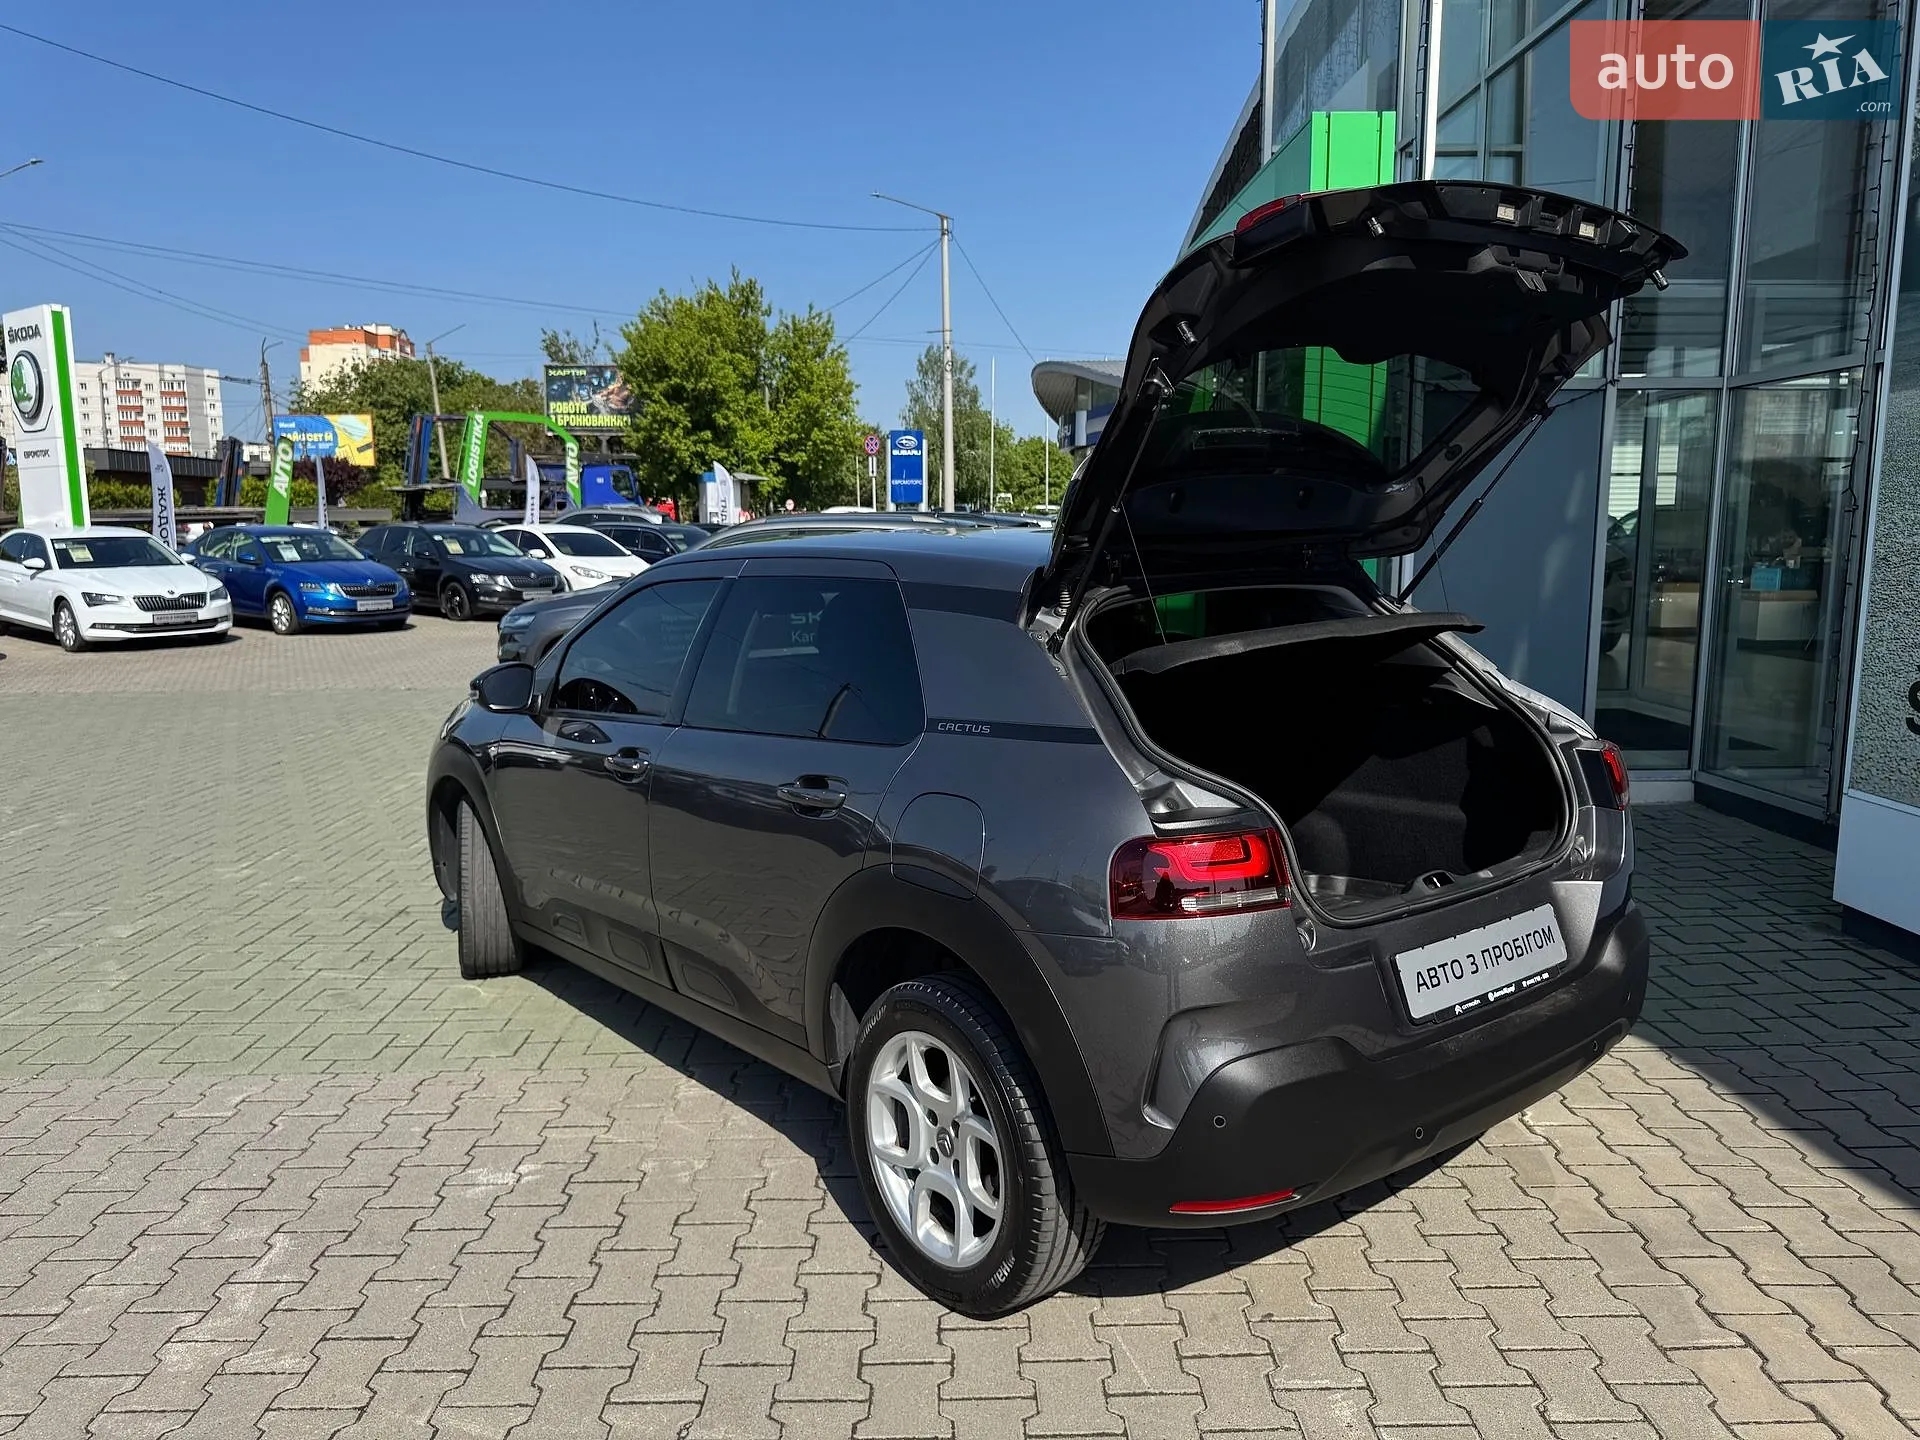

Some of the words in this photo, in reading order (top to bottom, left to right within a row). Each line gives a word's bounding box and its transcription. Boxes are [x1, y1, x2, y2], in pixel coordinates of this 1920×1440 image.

[8, 324, 42, 344] ŠKODA
[549, 401, 588, 414] РОБОТА
[273, 440, 293, 499] AVTO
[467, 413, 484, 487] LOGISTIKA
[566, 442, 579, 488] AVTO
[937, 722, 991, 733] CACTUS
[1415, 958, 1465, 993] АВТО
[1466, 953, 1479, 975] З
[1480, 925, 1556, 970] ПРОБІГОМ
